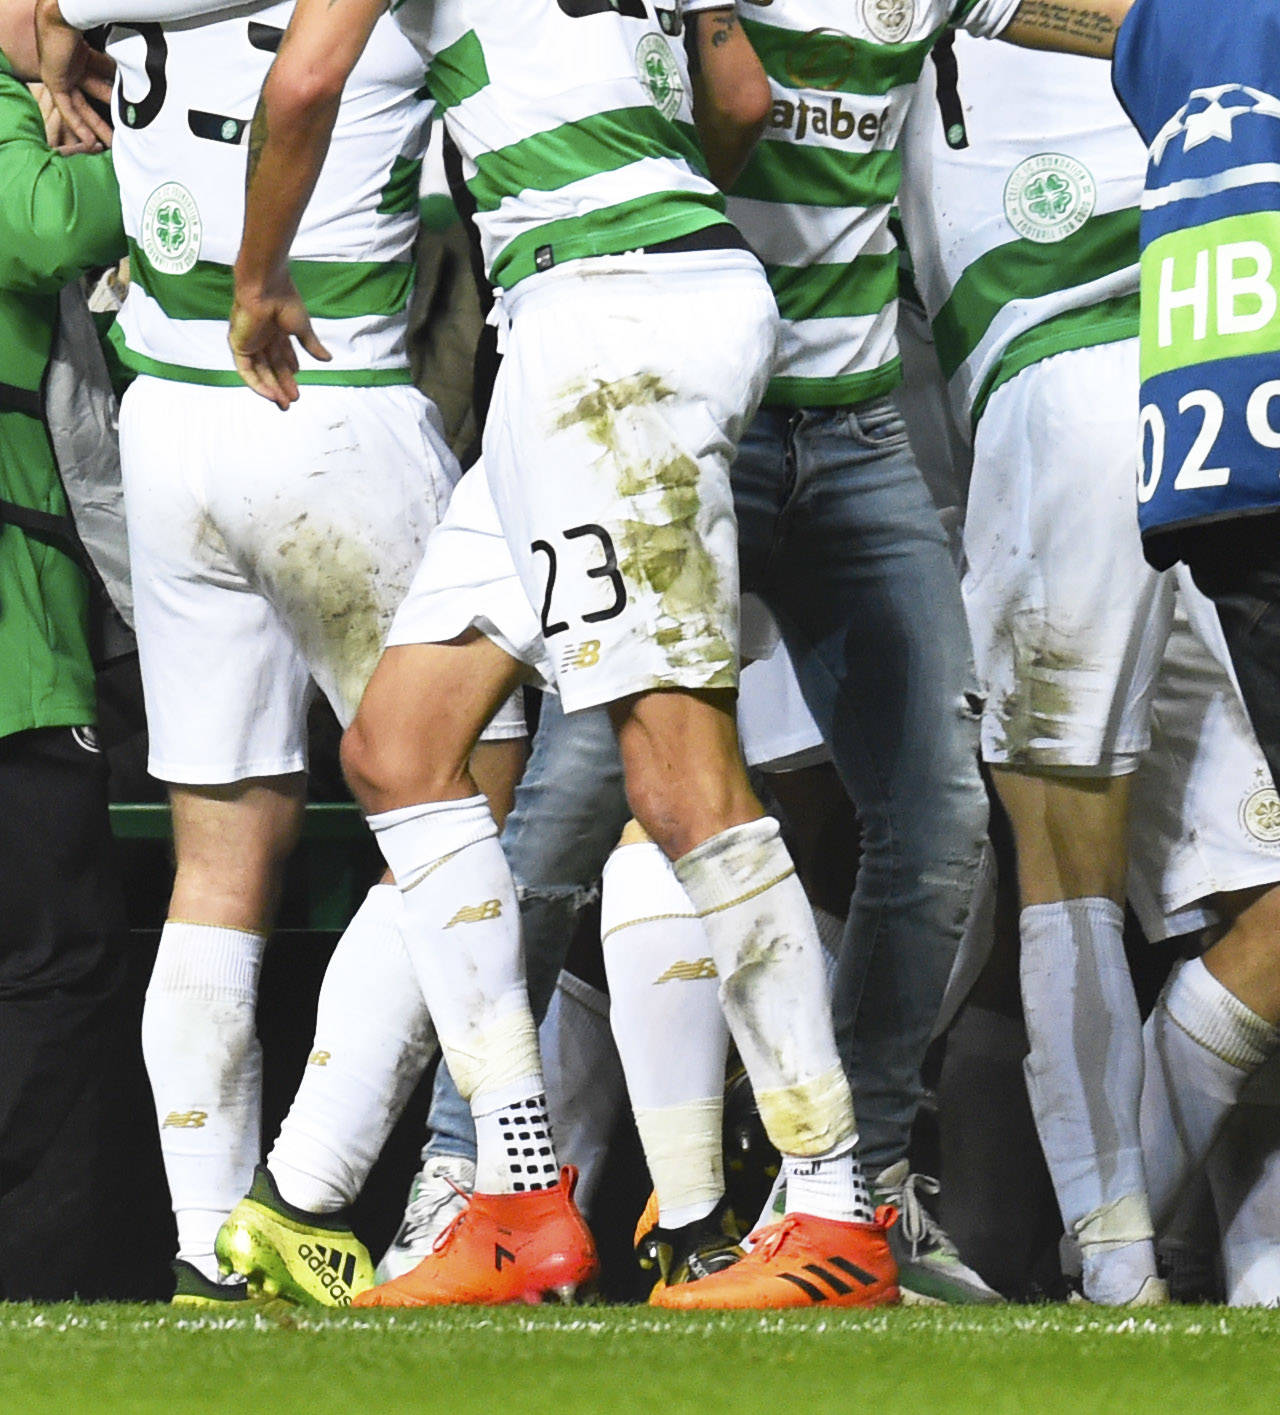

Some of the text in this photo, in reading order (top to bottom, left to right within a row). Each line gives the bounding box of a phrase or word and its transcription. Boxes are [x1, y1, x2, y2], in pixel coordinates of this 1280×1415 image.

[770, 97, 890, 142] afabe
[1157, 240, 1277, 348] HB
[531, 523, 627, 638] 23
[298, 1244, 353, 1307] adidas
